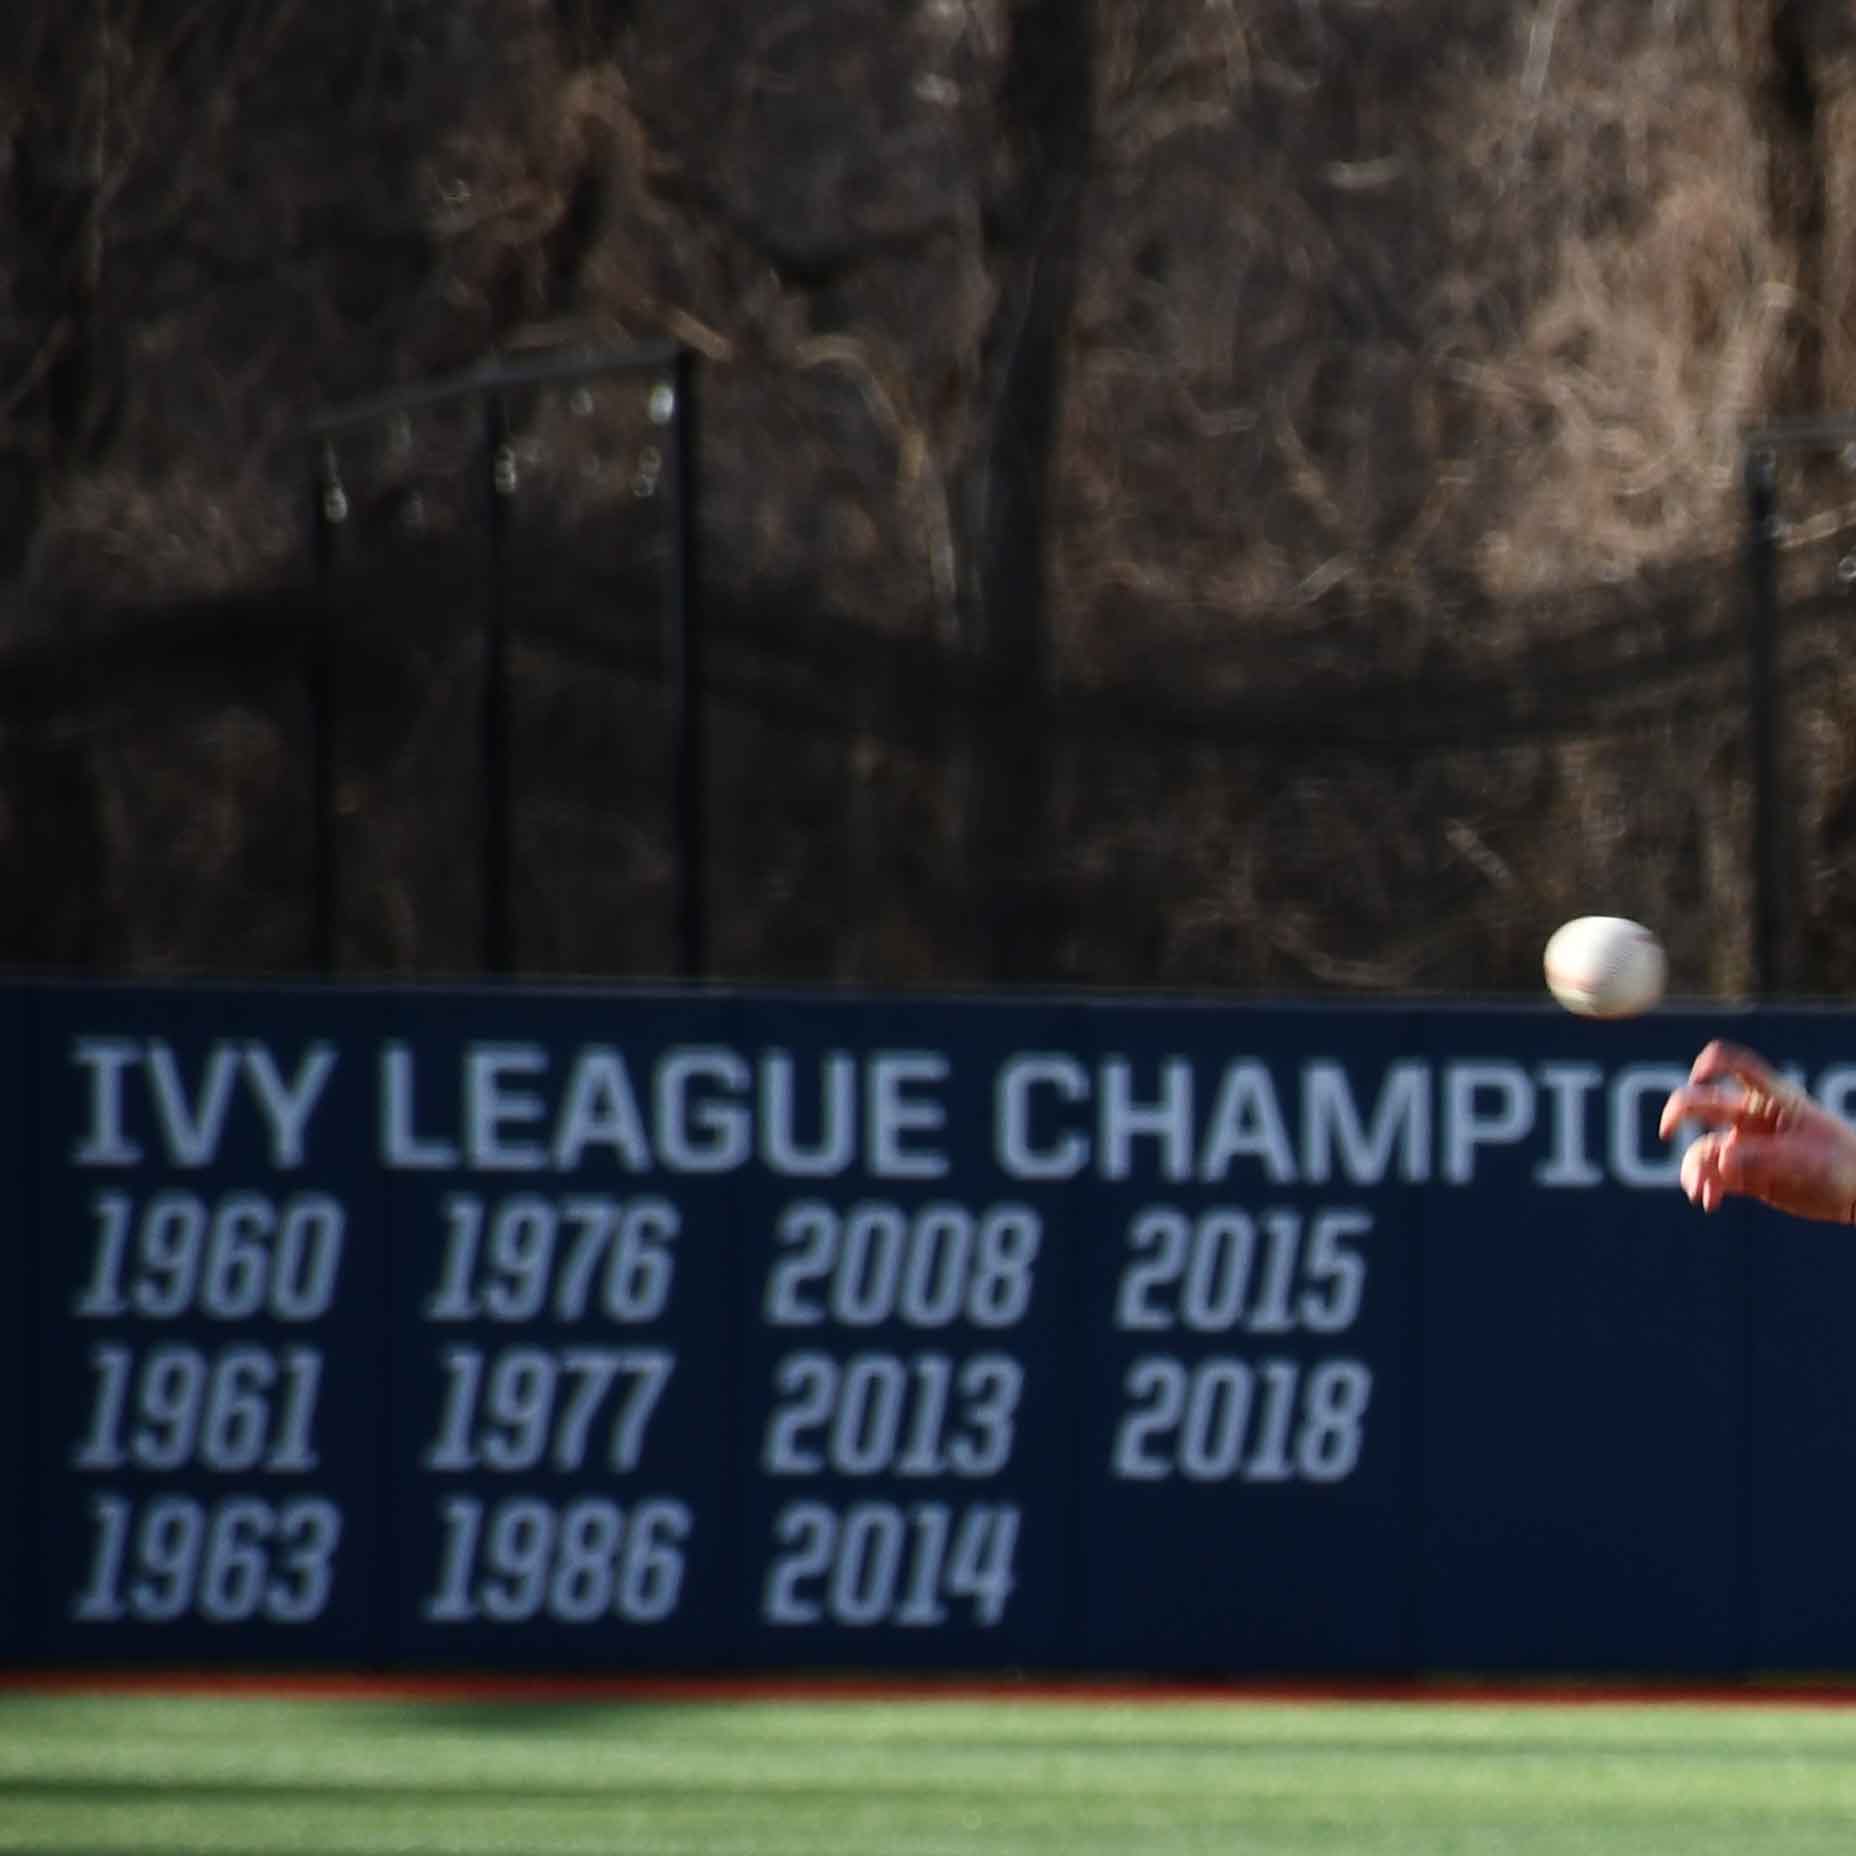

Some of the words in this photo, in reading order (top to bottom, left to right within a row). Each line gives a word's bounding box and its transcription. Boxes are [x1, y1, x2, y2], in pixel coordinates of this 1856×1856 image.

[74, 1041, 337, 1167] IVY
[381, 1045, 950, 1178] LEAGUE
[78, 1196, 344, 1317] 1960
[427, 1198, 679, 1321] 1976
[767, 1204, 1041, 1326] 2008
[1117, 1211, 1371, 1332] 2015
[77, 1349, 321, 1469] 1961
[427, 1350, 674, 1470] 1977
[765, 1354, 1023, 1475] 2013
[1113, 1359, 1372, 1481] 2018
[78, 1499, 341, 1621] 1963
[427, 1499, 691, 1622] 1986
[766, 1503, 1019, 1624] 2014
